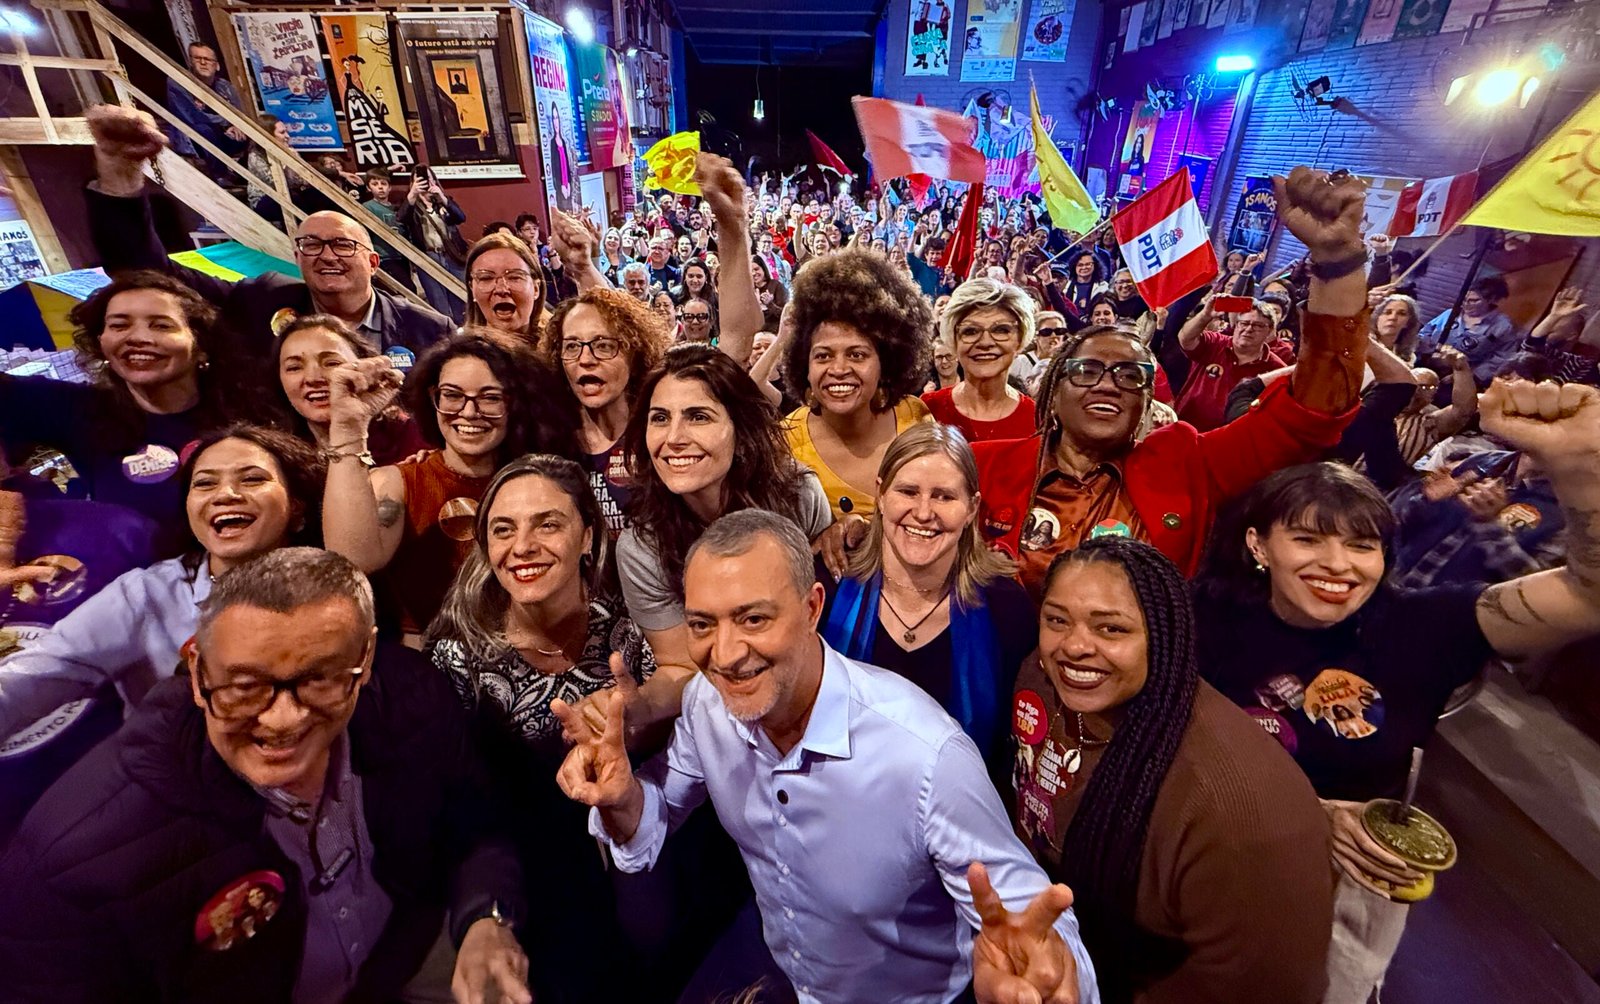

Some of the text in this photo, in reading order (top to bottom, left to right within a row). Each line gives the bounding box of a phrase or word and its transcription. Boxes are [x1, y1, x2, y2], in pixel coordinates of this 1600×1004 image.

[415, 39, 441, 47] futuro
[533, 55, 567, 92] REGINA
[1417, 212, 1441, 223] PDT
[1138, 233, 1162, 269] PDT
